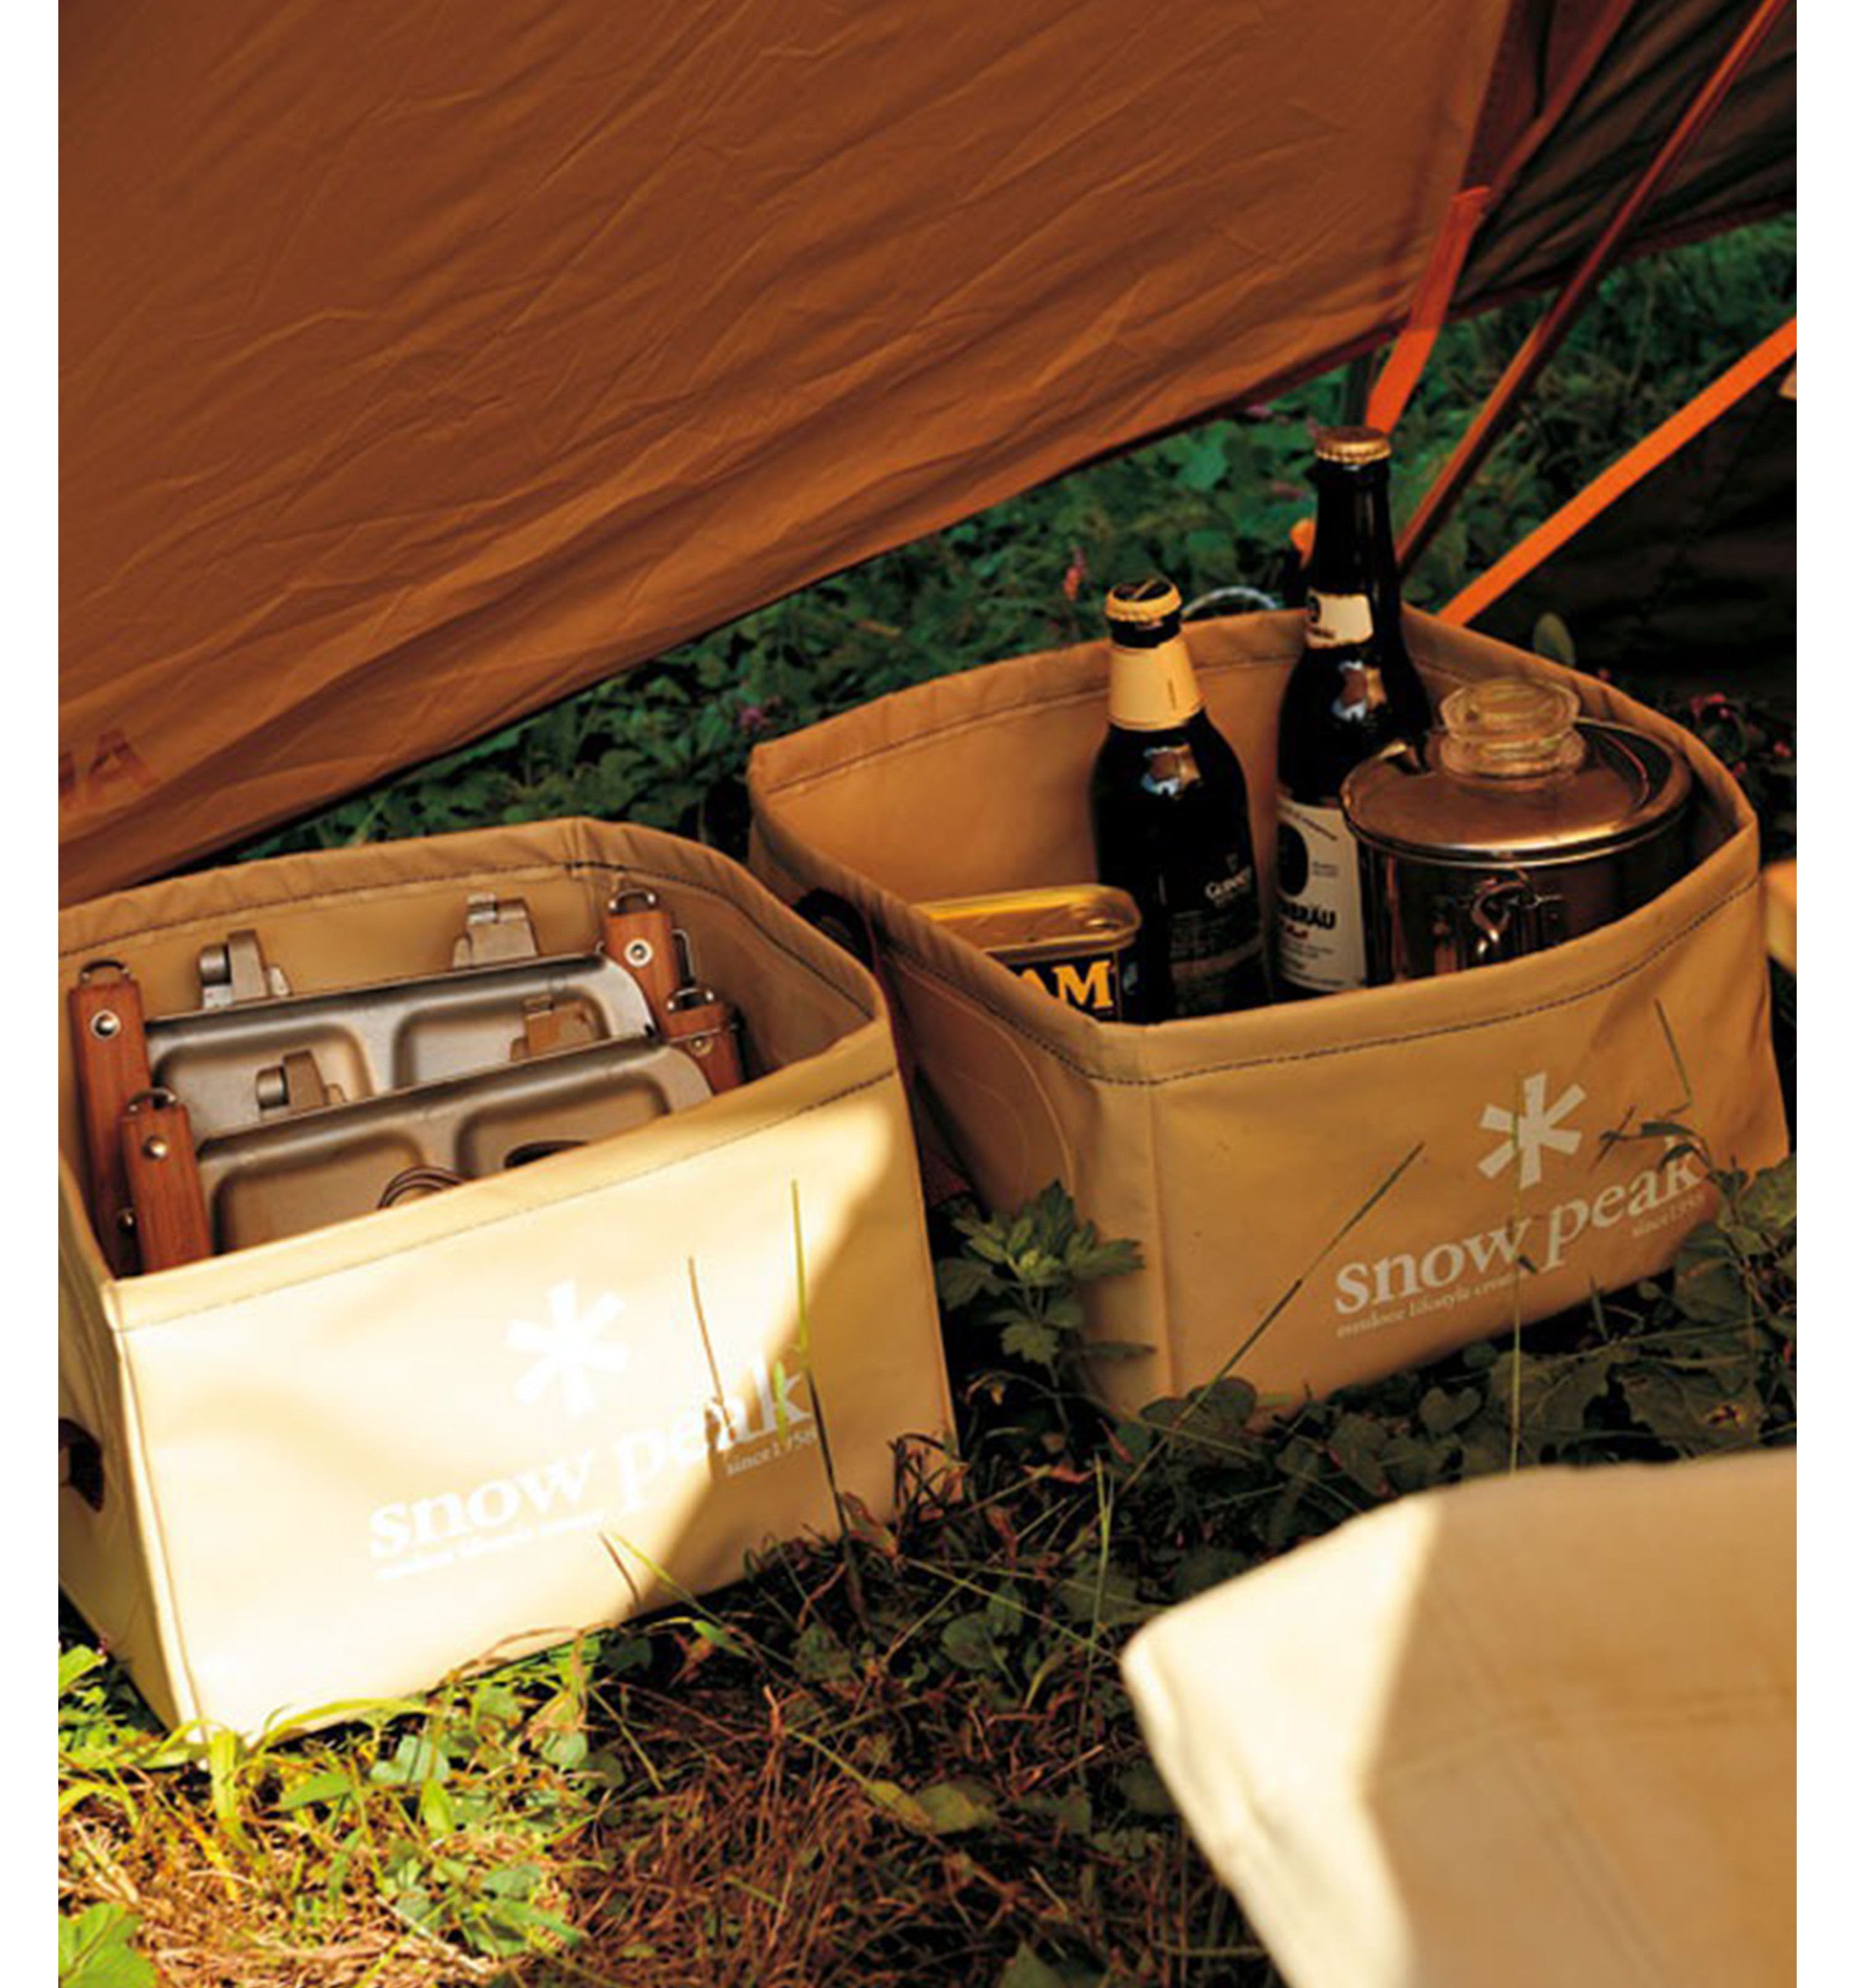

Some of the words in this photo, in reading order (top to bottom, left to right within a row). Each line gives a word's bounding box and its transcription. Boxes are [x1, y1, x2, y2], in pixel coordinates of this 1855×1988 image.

[1334, 1217, 1532, 1315] snow
[1540, 1134, 1703, 1272] peak
[368, 1446, 593, 1558] snow
[613, 1349, 815, 1513] peak
